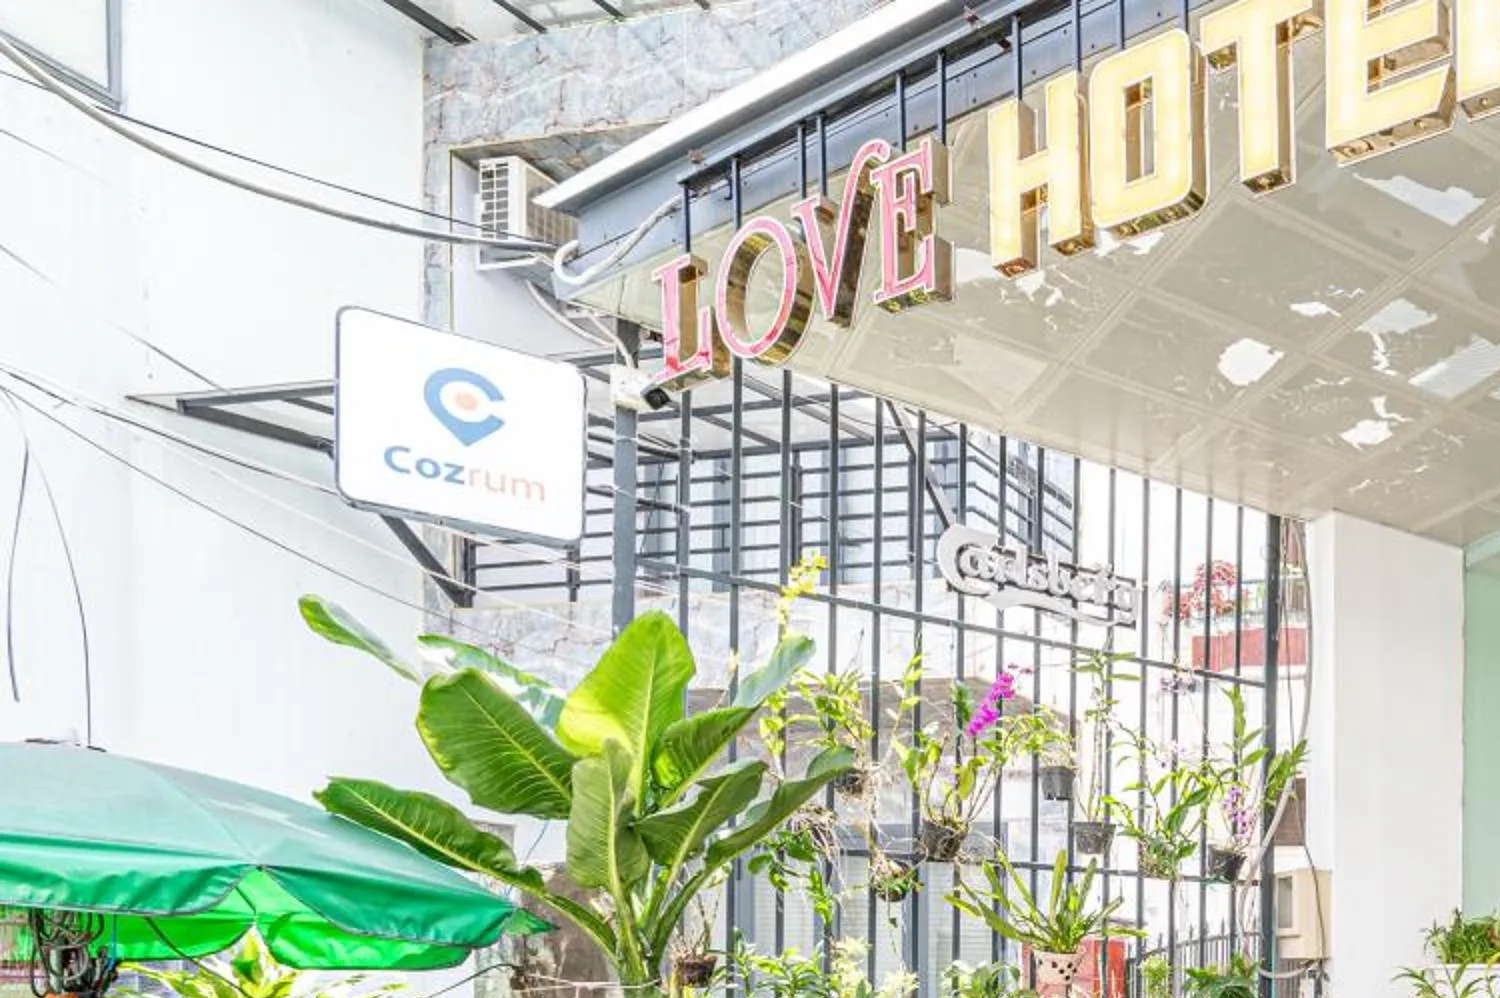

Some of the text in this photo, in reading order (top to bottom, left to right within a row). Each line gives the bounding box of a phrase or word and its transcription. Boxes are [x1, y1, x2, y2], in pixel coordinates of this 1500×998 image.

[650, 137, 941, 386] LOVE
[382, 444, 546, 503] Cozrum
[936, 523, 1144, 629] Carlsberg
